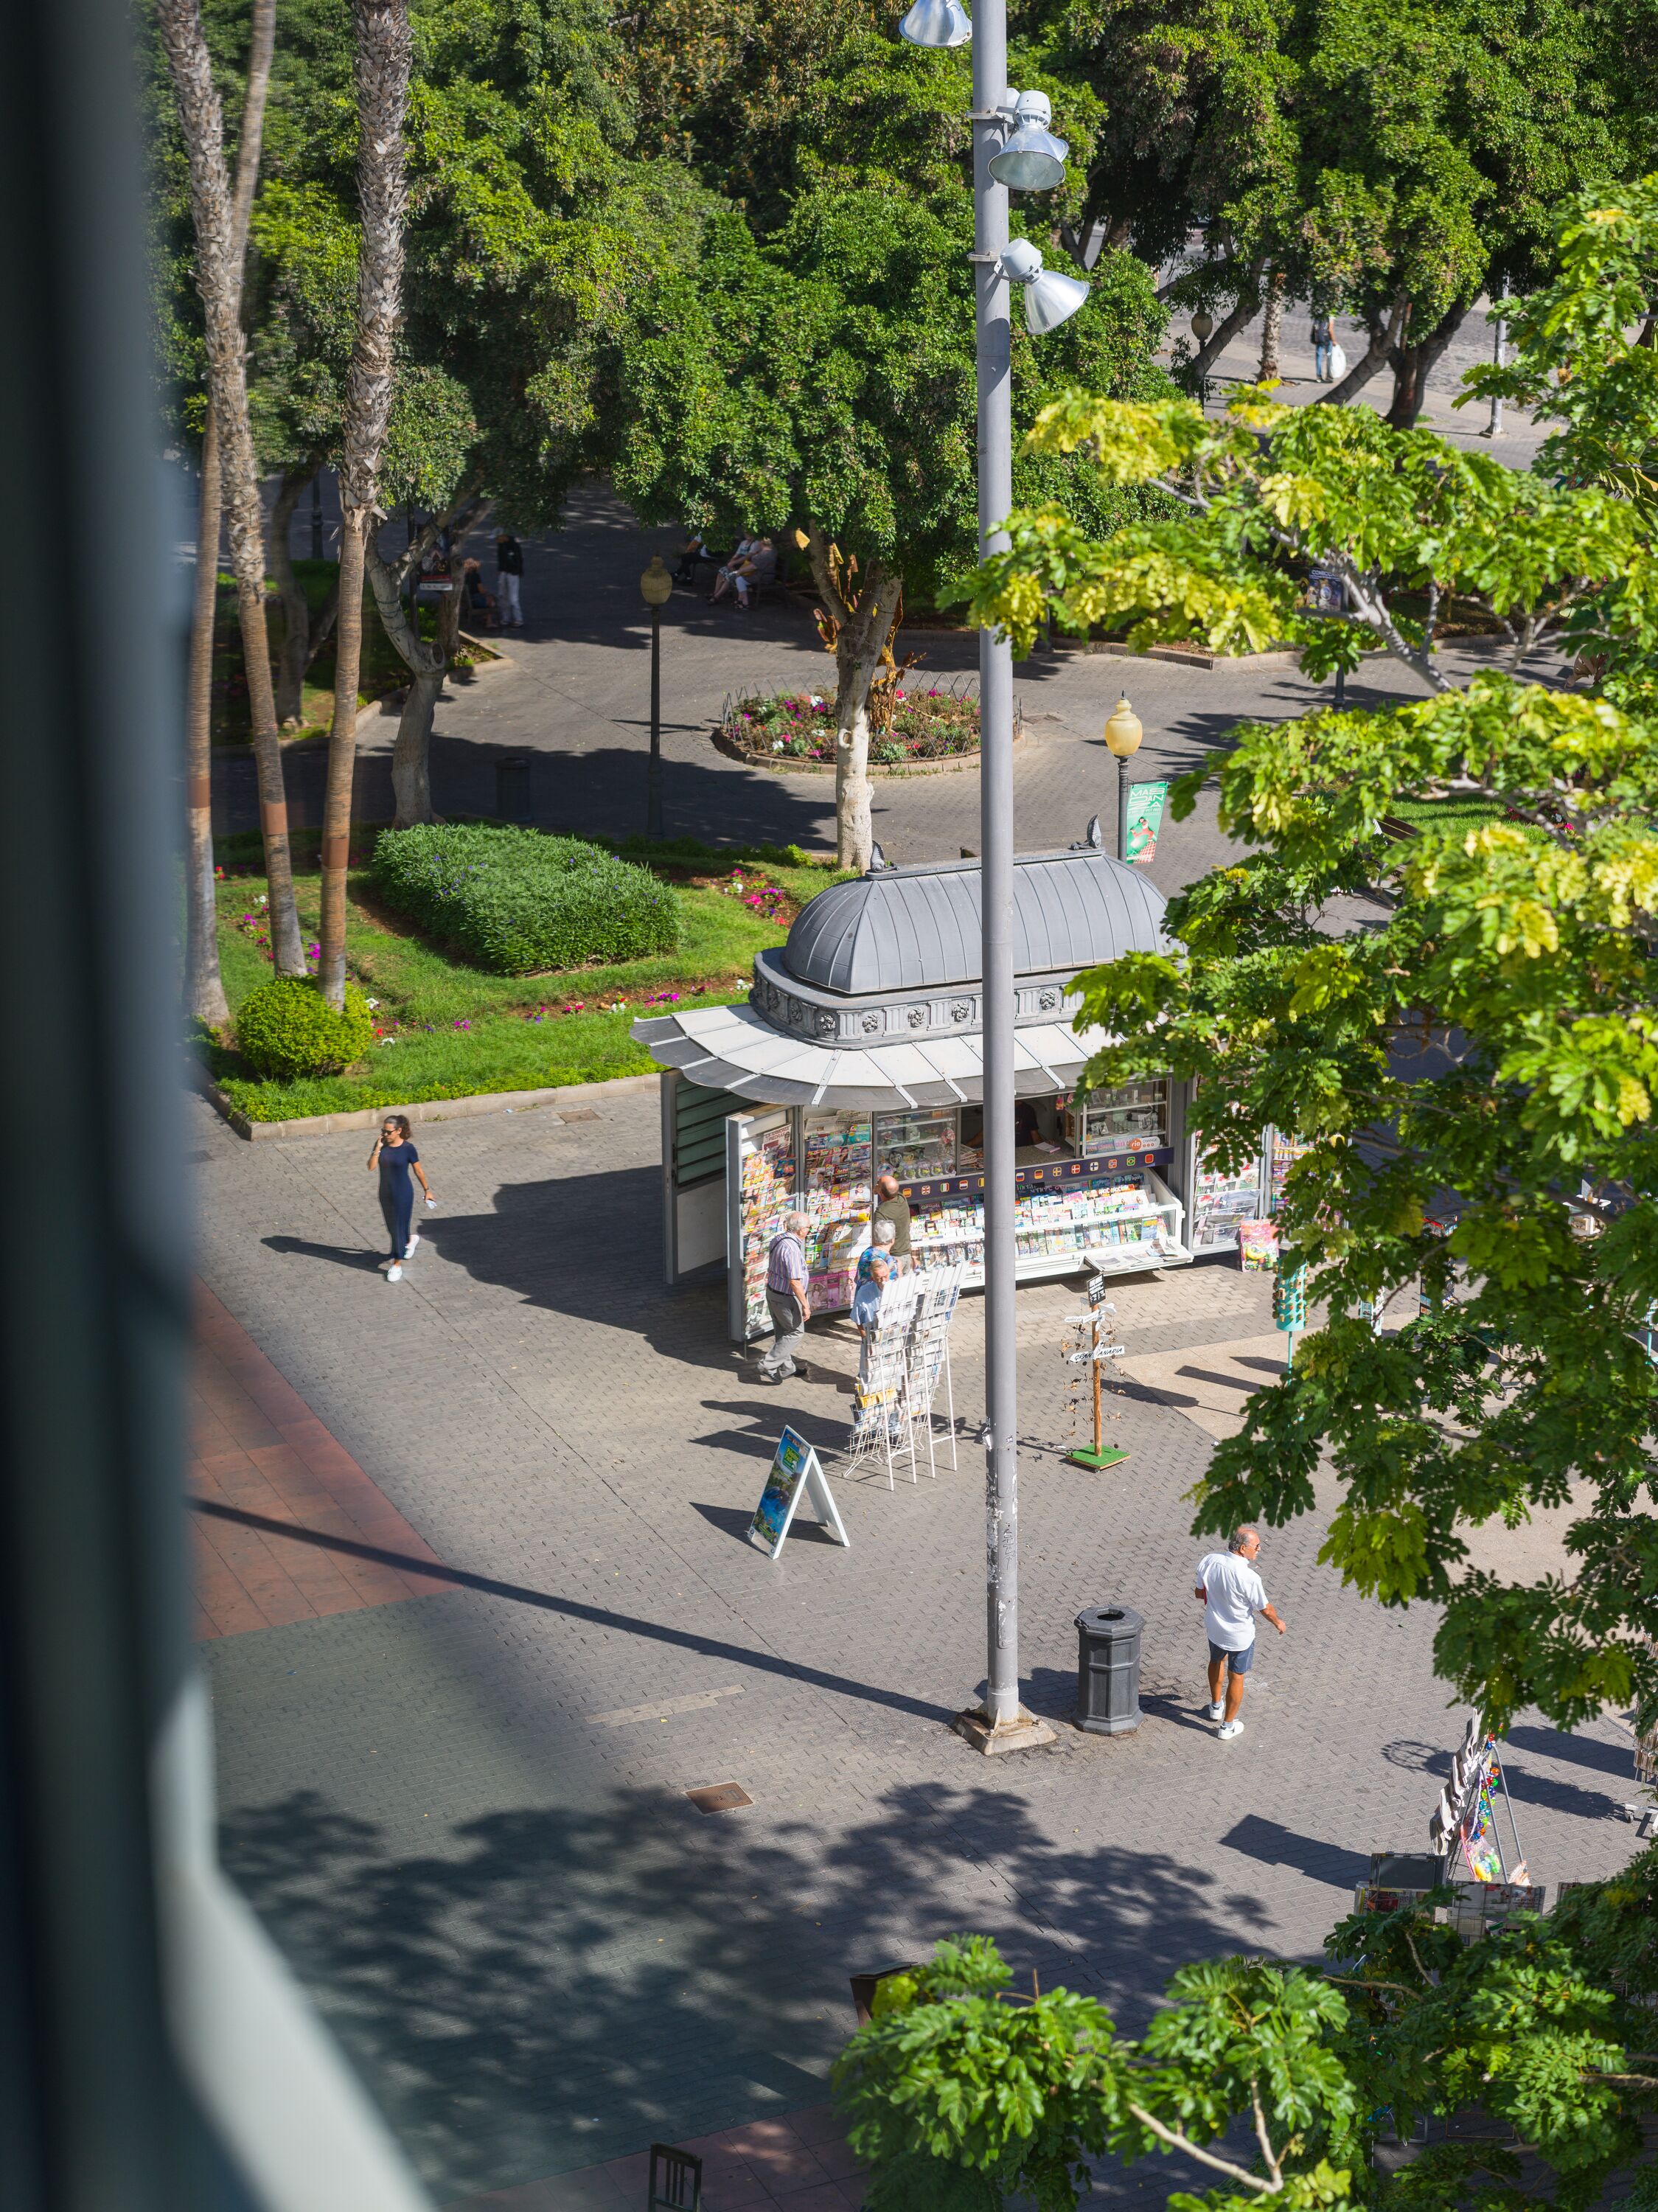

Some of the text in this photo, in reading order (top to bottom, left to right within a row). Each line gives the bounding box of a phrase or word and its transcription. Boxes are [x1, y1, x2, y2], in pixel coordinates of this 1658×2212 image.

[1131, 787, 1165, 797] MAS
[1129, 794, 1164, 804] DAN
[1074, 1348, 1123, 1360] GRAN ANARIA
